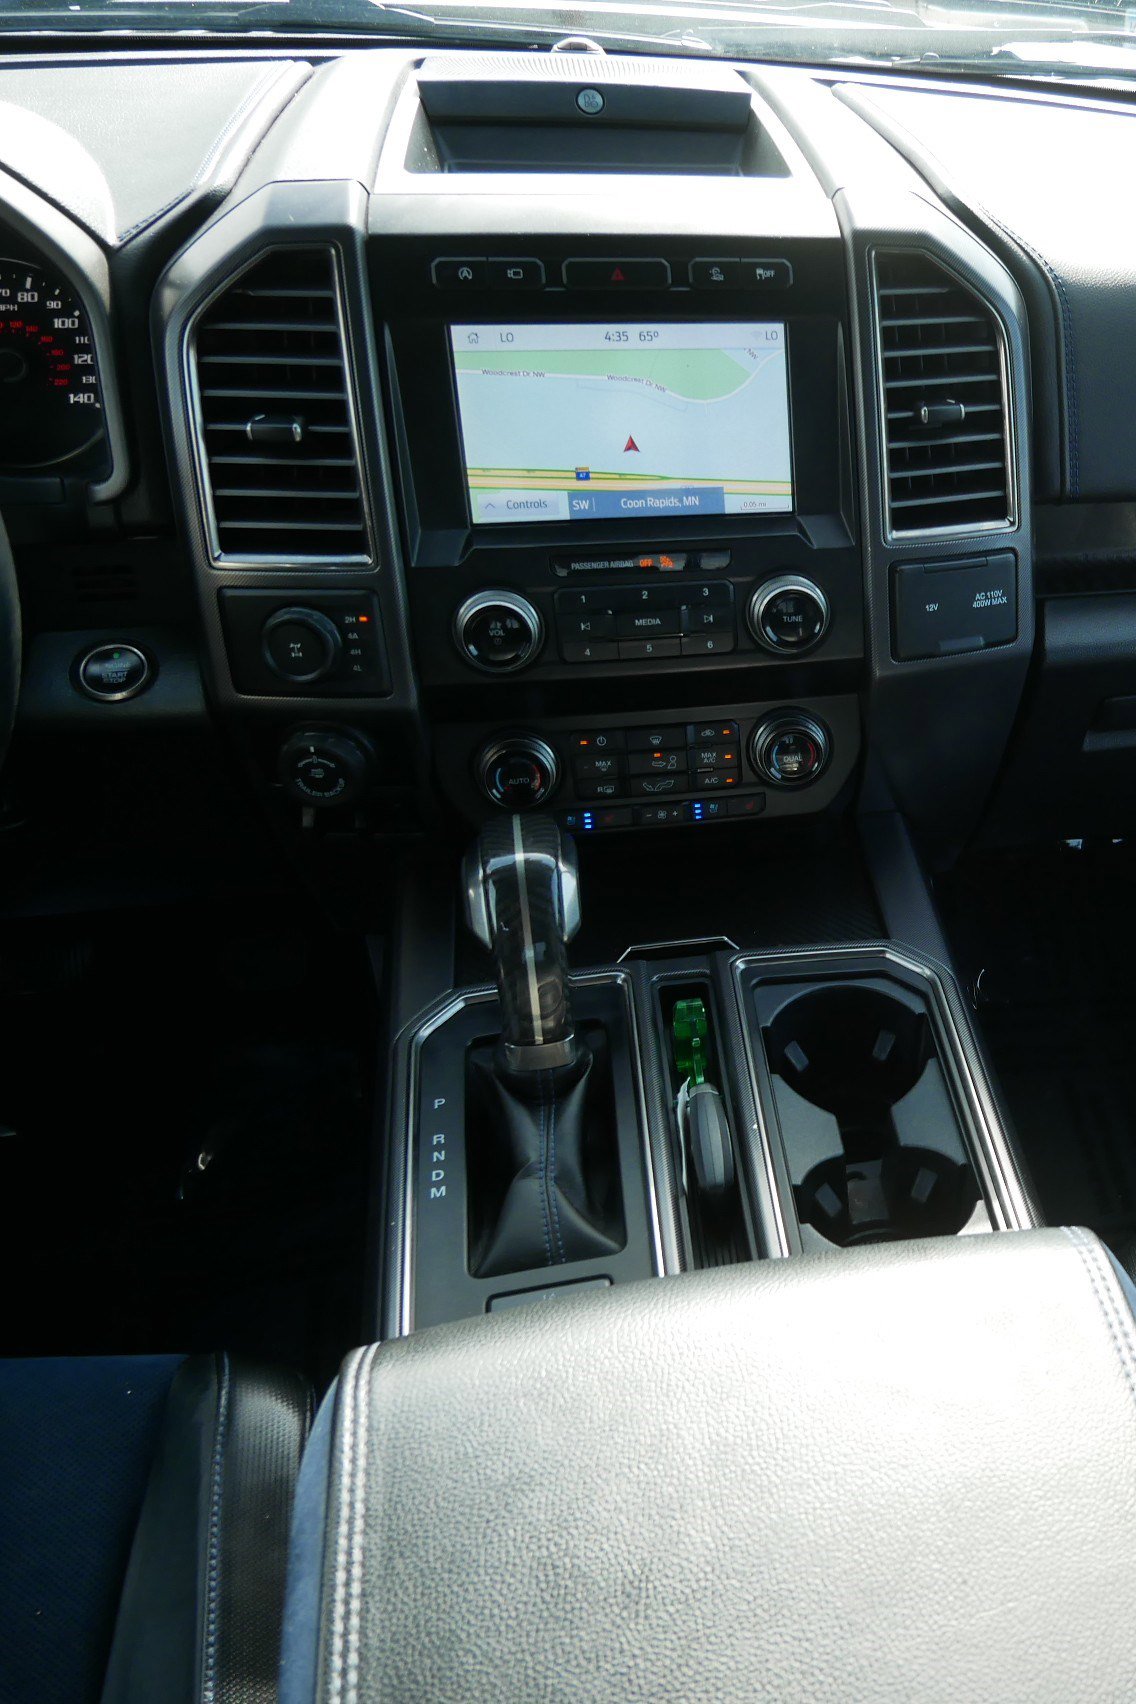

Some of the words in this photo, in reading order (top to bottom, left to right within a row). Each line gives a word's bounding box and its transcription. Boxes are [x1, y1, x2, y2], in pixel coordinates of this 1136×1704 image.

[764, 270, 775, 278] OFF
[17, 291, 38, 302] 80
[46, 300, 62, 310] 90
[53, 318, 79, 329] 100
[500, 332, 514, 343] LO
[604, 331, 629, 342] 4:35
[765, 330, 778, 341] LO
[481, 368, 521, 378] Woodcrest
[532, 370, 546, 378] NW
[606, 374, 644, 384] Woodcrest
[654, 384, 668, 393] NW
[68, 393, 95, 404] 140
[506, 498, 548, 510] Controls
[572, 500, 589, 511] SW
[620, 498, 646, 509] Coon
[647, 496, 682, 509] Rapids,
[683, 496, 700, 506] MN
[571, 561, 609, 570] PASSENGER
[610, 560, 634, 568] AIRBAG
[639, 558, 654, 568] OFF
[642, 590, 648, 600] 2
[702, 587, 709, 596] 3
[975, 592, 986, 600] AC
[986, 590, 1003, 598] 110V
[925, 603, 938, 612] 12V
[972, 599, 991, 608] 400W
[992, 596, 1008, 606] MAX
[344, 616, 356, 624] 2H
[634, 618, 662, 626] MEDIA
[646, 644, 652, 652] 5
[707, 640, 714, 649] 6
[584, 648, 591, 656] 4
[434, 1098, 446, 1109] P
[433, 1134, 445, 1146] R
[432, 1150, 445, 1162] N
[432, 1170, 444, 1182] D
[430, 1185, 446, 1199] M
